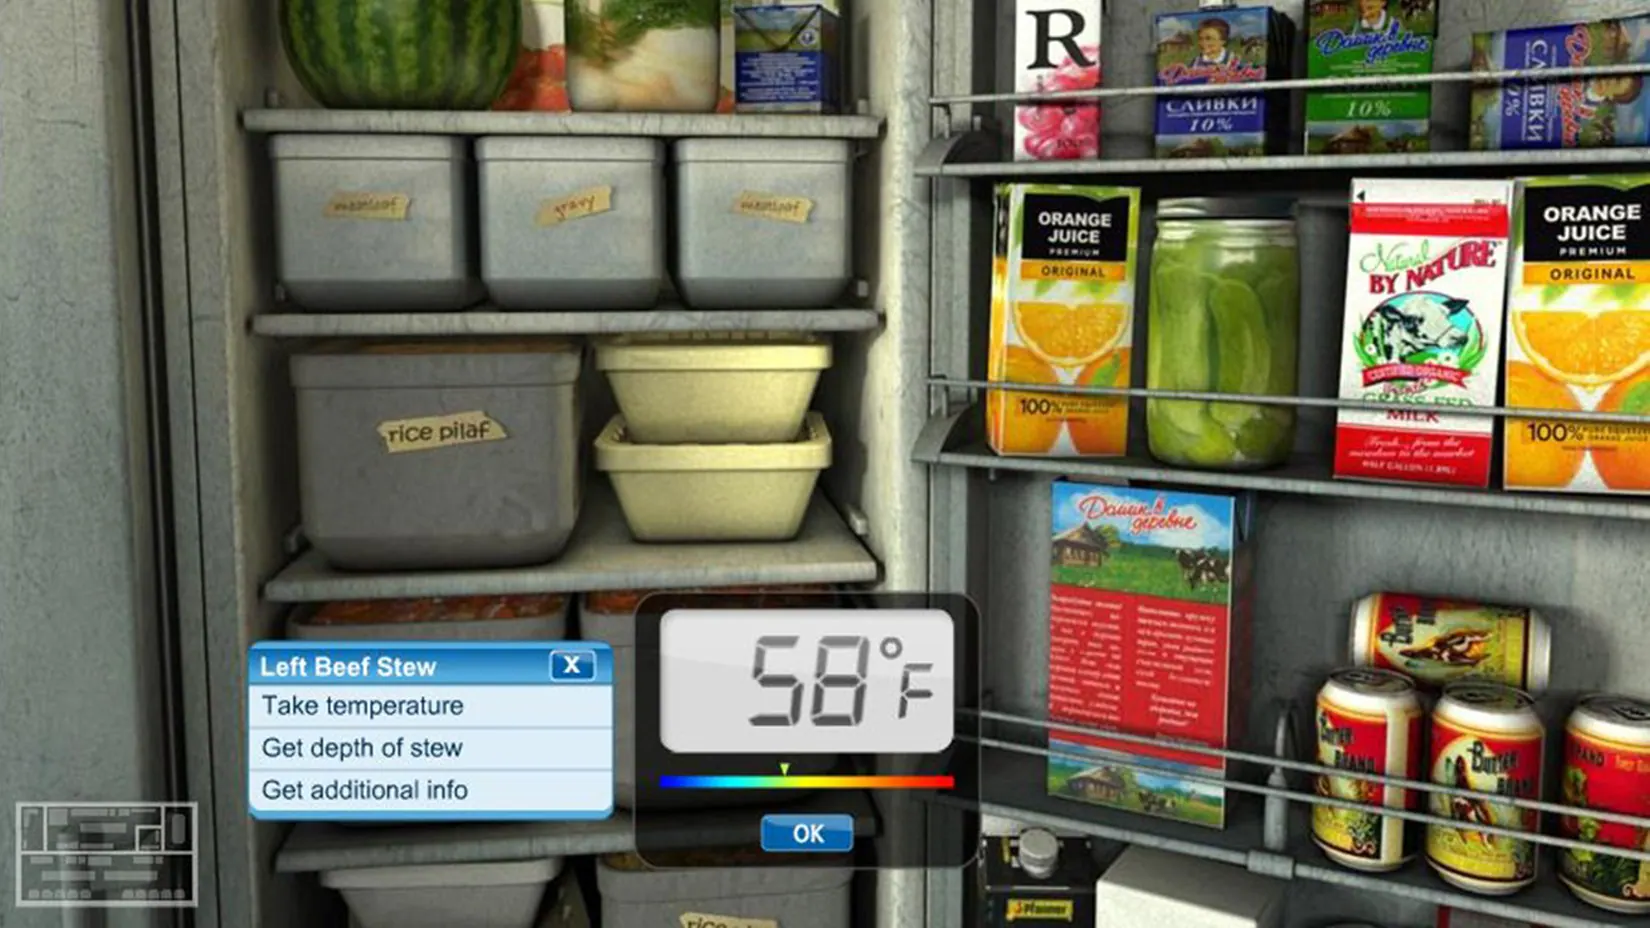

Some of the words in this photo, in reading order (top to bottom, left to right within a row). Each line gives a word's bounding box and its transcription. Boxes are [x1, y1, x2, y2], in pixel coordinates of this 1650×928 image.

[1025, 9, 1096, 70] R
[1165, 98, 1258, 113] СЛИВКИ
[1347, 100, 1392, 118] 10%
[1190, 117, 1234, 132] 10%
[555, 194, 596, 222] gravy
[1543, 204, 1641, 222] ORANGE
[1037, 211, 1112, 228] ORANGE
[1047, 229, 1101, 244] JUICE
[1556, 224, 1627, 242] JUICE
[1049, 247, 1101, 257] PREMIUM
[1359, 239, 1429, 274] Natural
[1558, 244, 1627, 256] PREMIUM
[1041, 264, 1107, 278] ORIGINAL
[1369, 273, 1400, 294] BY
[1406, 240, 1497, 292] NATURE
[1549, 265, 1636, 282] ORIGINAL
[1387, 408, 1441, 423] MILK
[388, 423, 434, 443] rice
[439, 420, 490, 442] pilaf
[1526, 423, 1585, 443] 100%
[1078, 495, 1148, 520] Домик
